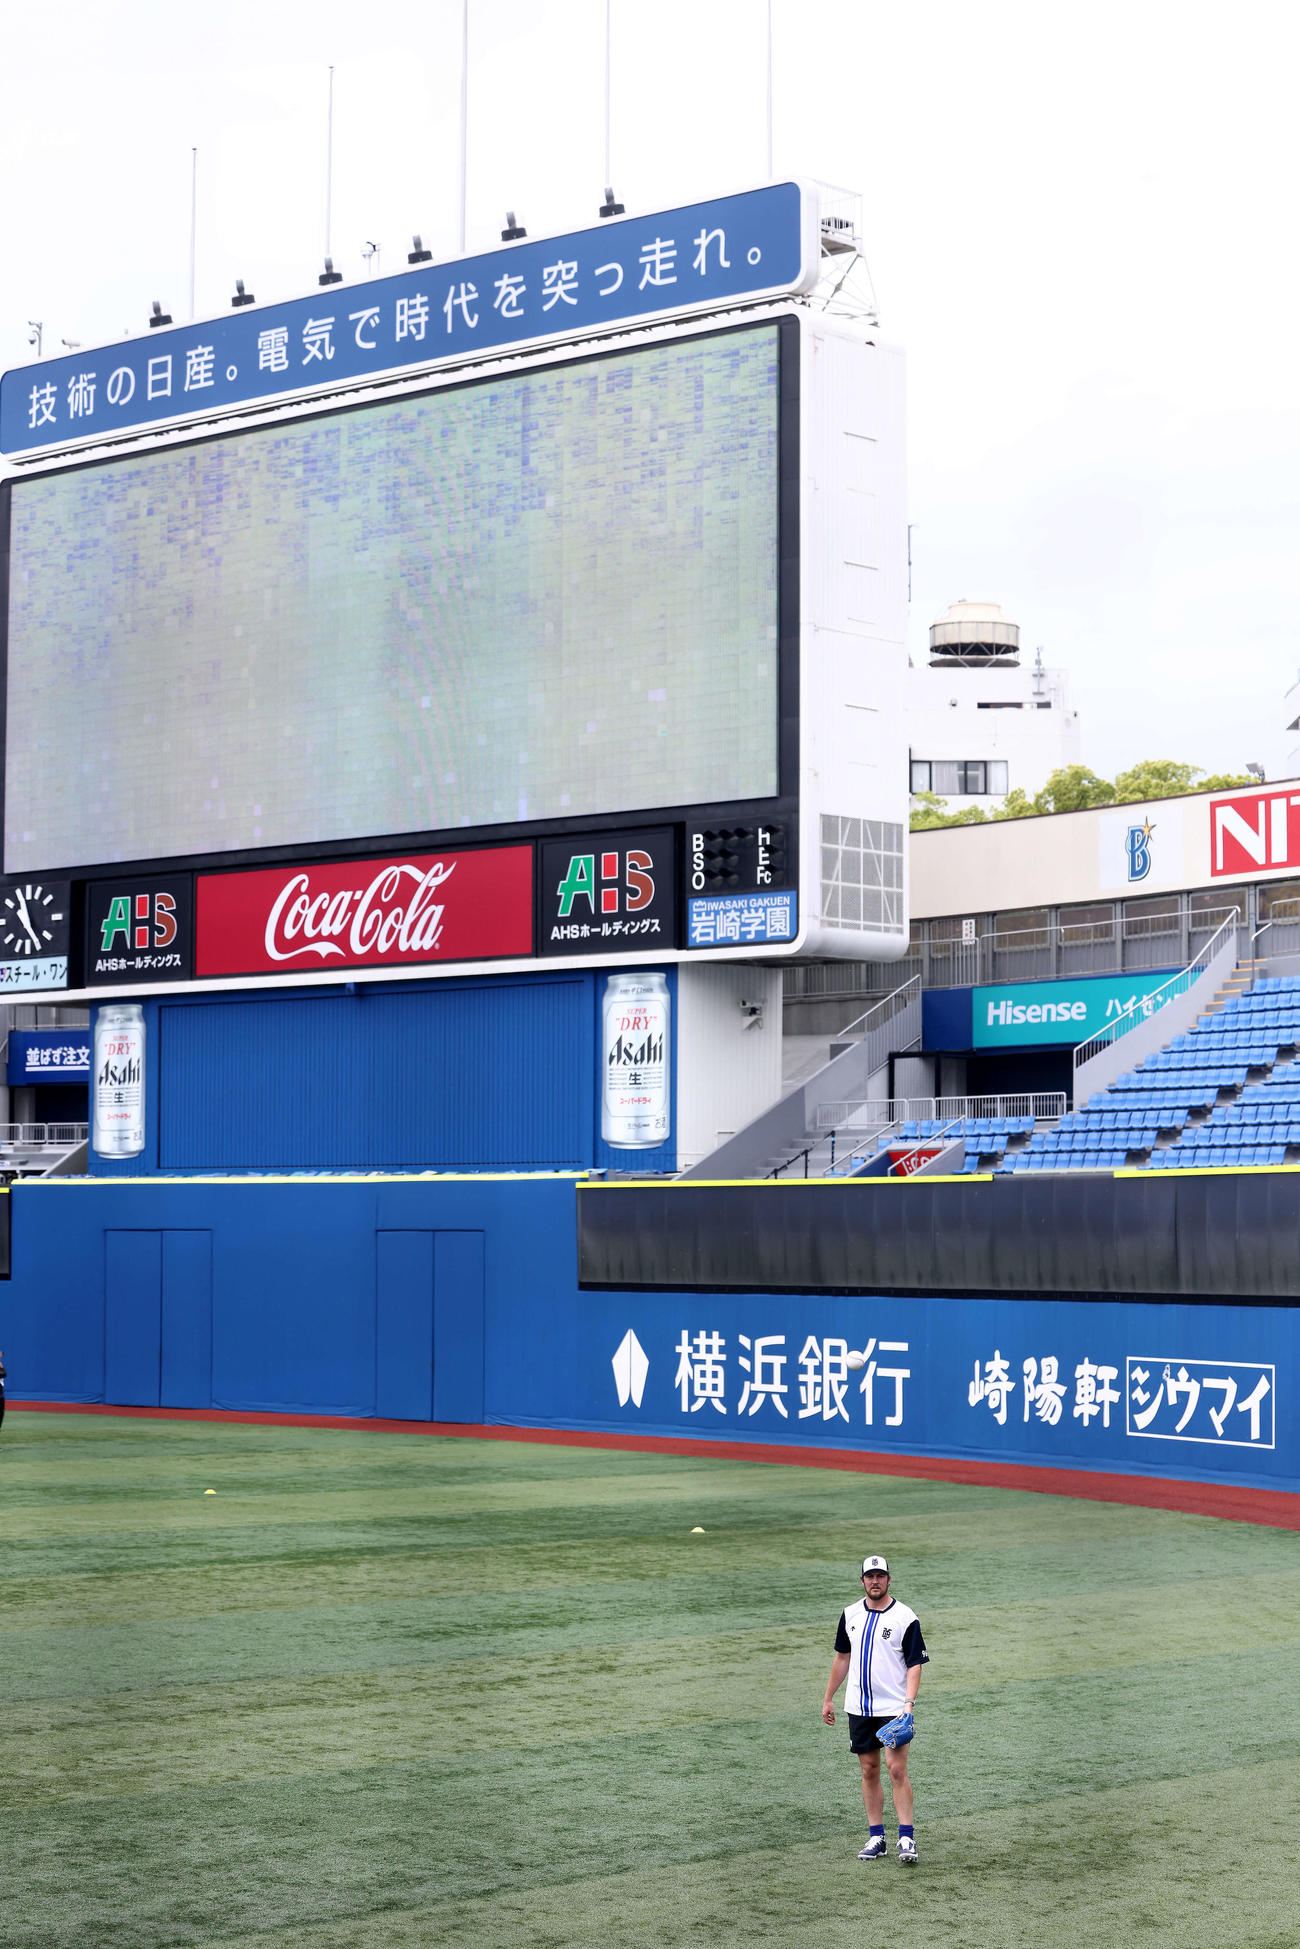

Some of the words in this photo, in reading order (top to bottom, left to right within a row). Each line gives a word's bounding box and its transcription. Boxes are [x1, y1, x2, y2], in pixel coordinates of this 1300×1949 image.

[692, 833, 705, 852] B
[758, 827, 771, 846] H
[1215, 795, 1300, 871] NI
[692, 852, 705, 871] S
[758, 846, 770, 865] E
[556, 850, 655, 917] AHS
[691, 871, 705, 891] O
[264, 860, 457, 961] Coca-Cola
[707, 899, 748, 911] IWASAKI
[749, 896, 790, 907] GAKUEN
[100, 892, 178, 951] AHS
[550, 918, 661, 940] AHSホールディングス
[691, 906, 790, 943] 岩崎学園
[95, 953, 181, 972] AHSホールディングス
[987, 1000, 1087, 1026] Hisense
[25, 1046, 90, 1066] 並ばず注文
[608, 1031, 663, 1066] Asahi
[98, 1057, 140, 1086] Asahi
[629, 1071, 642, 1086] 生
[114, 1091, 124, 1104] 生
[674, 1329, 911, 1427] 横浜銀行
[968, 1349, 1122, 1428] 崎陽軒
